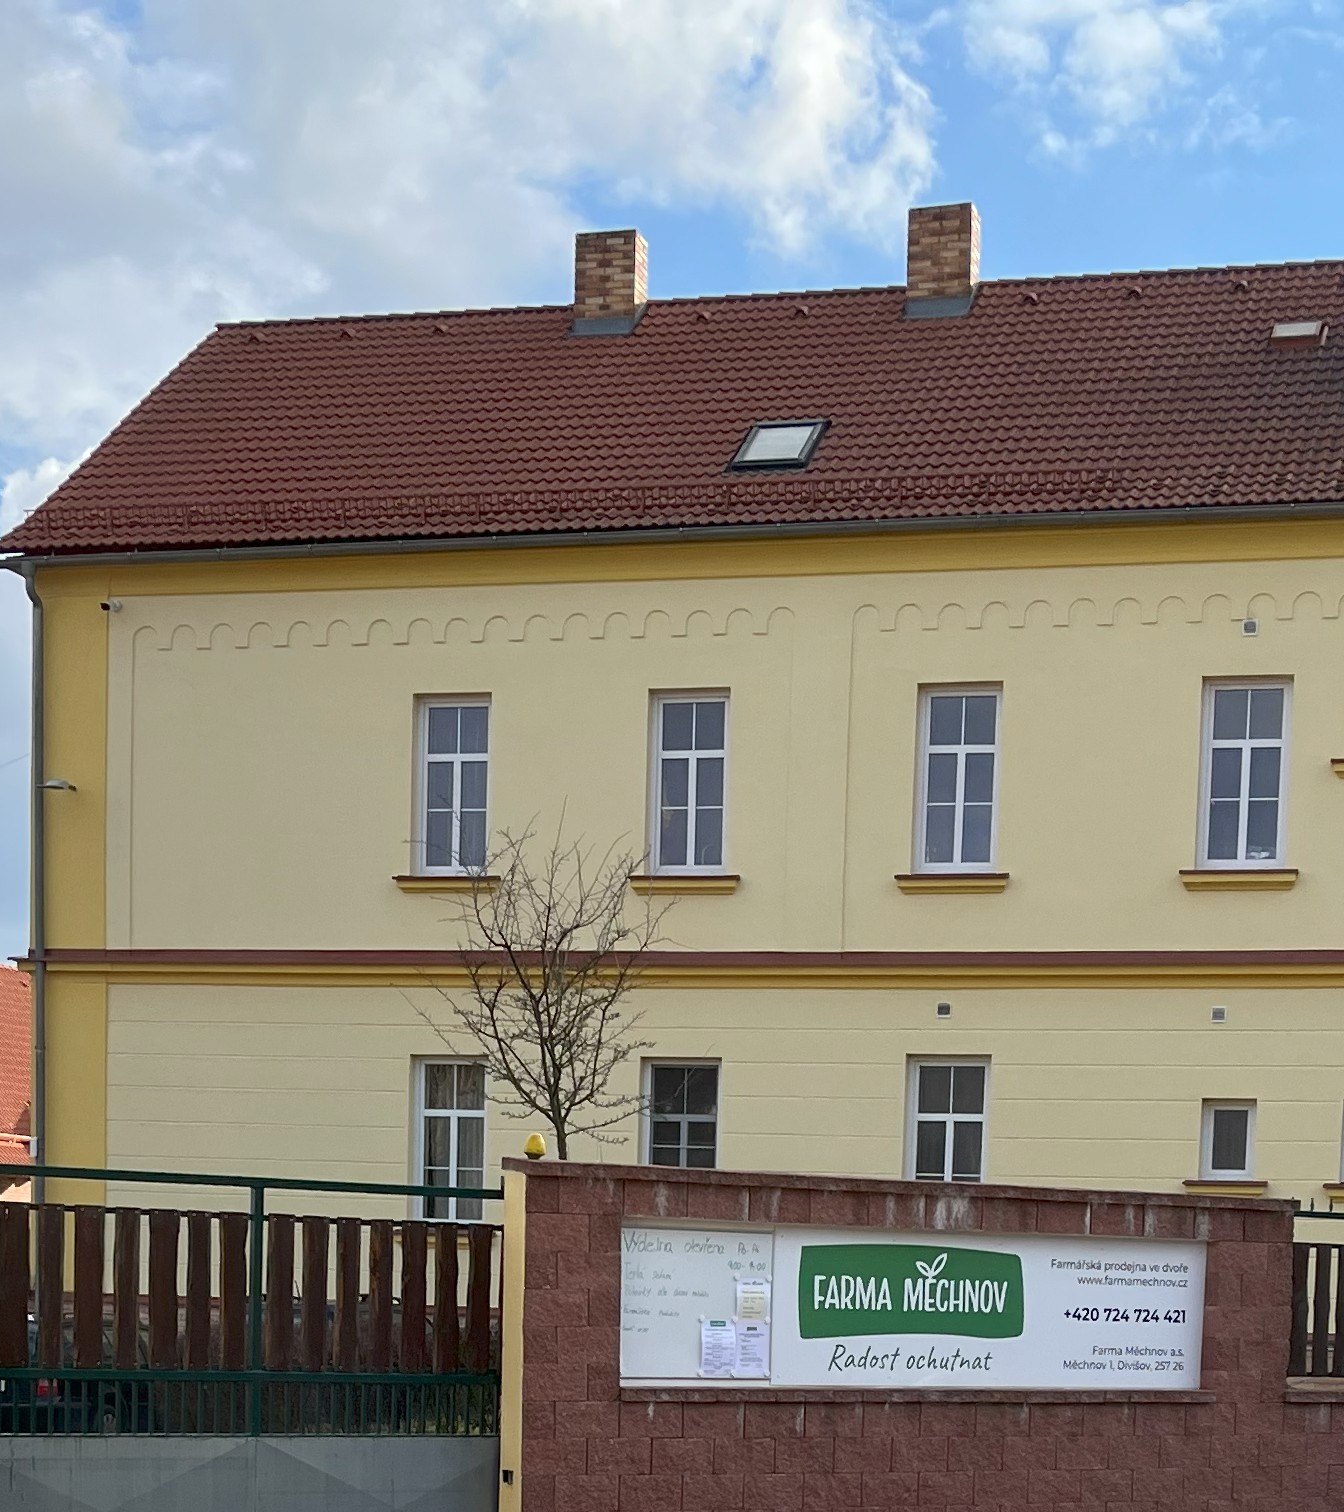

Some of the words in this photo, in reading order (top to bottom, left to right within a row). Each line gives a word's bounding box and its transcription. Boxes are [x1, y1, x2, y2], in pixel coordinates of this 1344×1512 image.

[1051, 1259, 1102, 1271] Farmářská
[1104, 1261, 1147, 1274] prodejna
[1149, 1264, 1160, 1272] ve
[1162, 1263, 1189, 1273] dvoře
[1077, 1275, 1188, 1288] www.farmamechnov.cz
[813, 1275, 893, 1311] FARMA
[1064, 1307, 1100, 1321] +420
[1103, 1308, 1130, 1322] 724
[1133, 1309, 1160, 1322] 724
[1163, 1309, 1187, 1323] 421
[828, 1344, 900, 1371] Radost
[906, 1346, 993, 1371] ochutnat
[1092, 1346, 1123, 1356] Farma
[1170, 1348, 1184, 1357] a.s.
[1063, 1360, 1107, 1370] Měchnov
[1154, 1361, 1171, 1371] 257
[1172, 1361, 1184, 1371] 26
